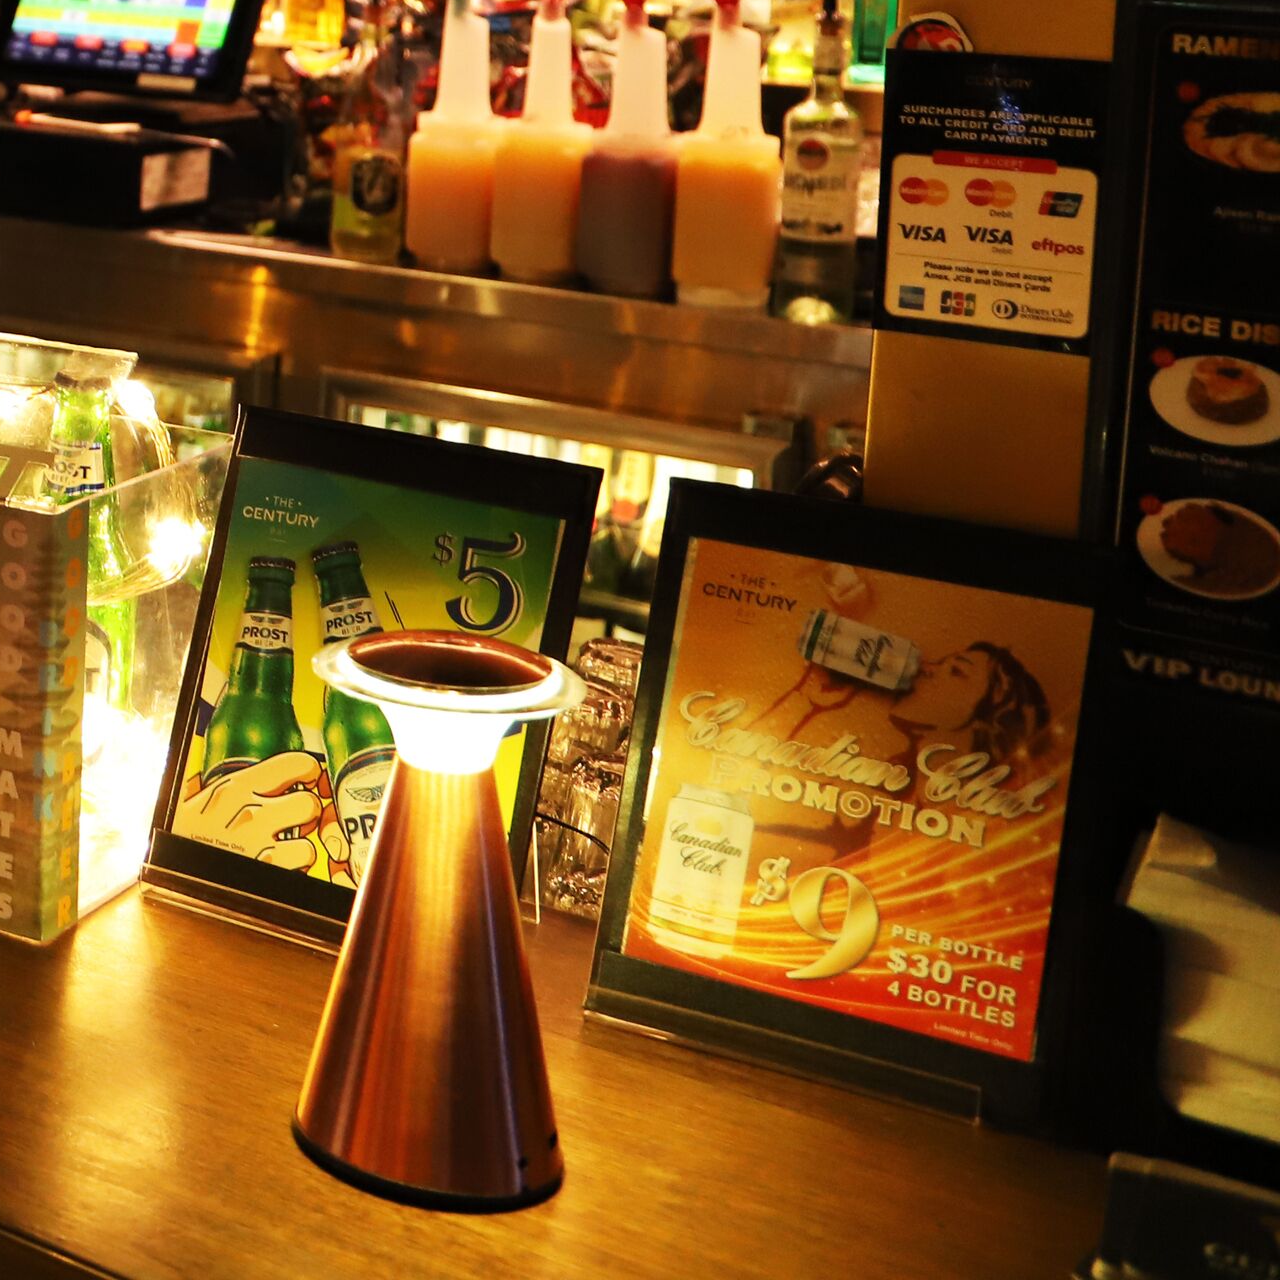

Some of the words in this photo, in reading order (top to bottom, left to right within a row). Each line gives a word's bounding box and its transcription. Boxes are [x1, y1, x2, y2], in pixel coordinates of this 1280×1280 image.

[898, 115, 916, 126] TO
[918, 117, 941, 128] ALL
[944, 118, 989, 131] CREDIT
[992, 122, 1027, 134] CARD
[1029, 125, 1056, 136] AND
[1059, 127, 1097, 139] DEBIT
[902, 104, 987, 119] SURCHARGES
[989, 110, 1014, 121] ARE
[1016, 112, 1095, 128] APPLICABLE
[944, 130, 978, 141] CARD
[980, 131, 1049, 147] PAYMENTS
[898, 223, 947, 243] VISA
[963, 225, 1014, 246] VISA
[1032, 238, 1085, 256] eftpos
[1022, 274, 1053, 284] accept
[1151, 310, 1222, 338] RICE
[273, 495, 295, 509] THE
[242, 505, 320, 529] CENTURY
[432, 531, 527, 637] $5
[741, 573, 766, 588] THE
[702, 582, 797, 611] CENTURY
[242, 626, 289, 644] PROST
[326, 611, 373, 633] PROST
[1122, 648, 1191, 680] VIP
[679, 690, 911, 793] Canadian
[917, 742, 1060, 819] Club
[708, 754, 987, 849] PROMOTION
[56, 750, 77, 929] BEER
[668, 819, 743, 860] Canadian
[680, 847, 720, 876] Club
[750, 856, 880, 980] $9
[892, 925, 932, 947] PER
[940, 934, 1024, 971] BOTTLE
[887, 947, 953, 986] $30
[961, 974, 1017, 1007] FOR
[887, 981, 900, 997] 4
[907, 983, 1016, 1029] BOTTLES
